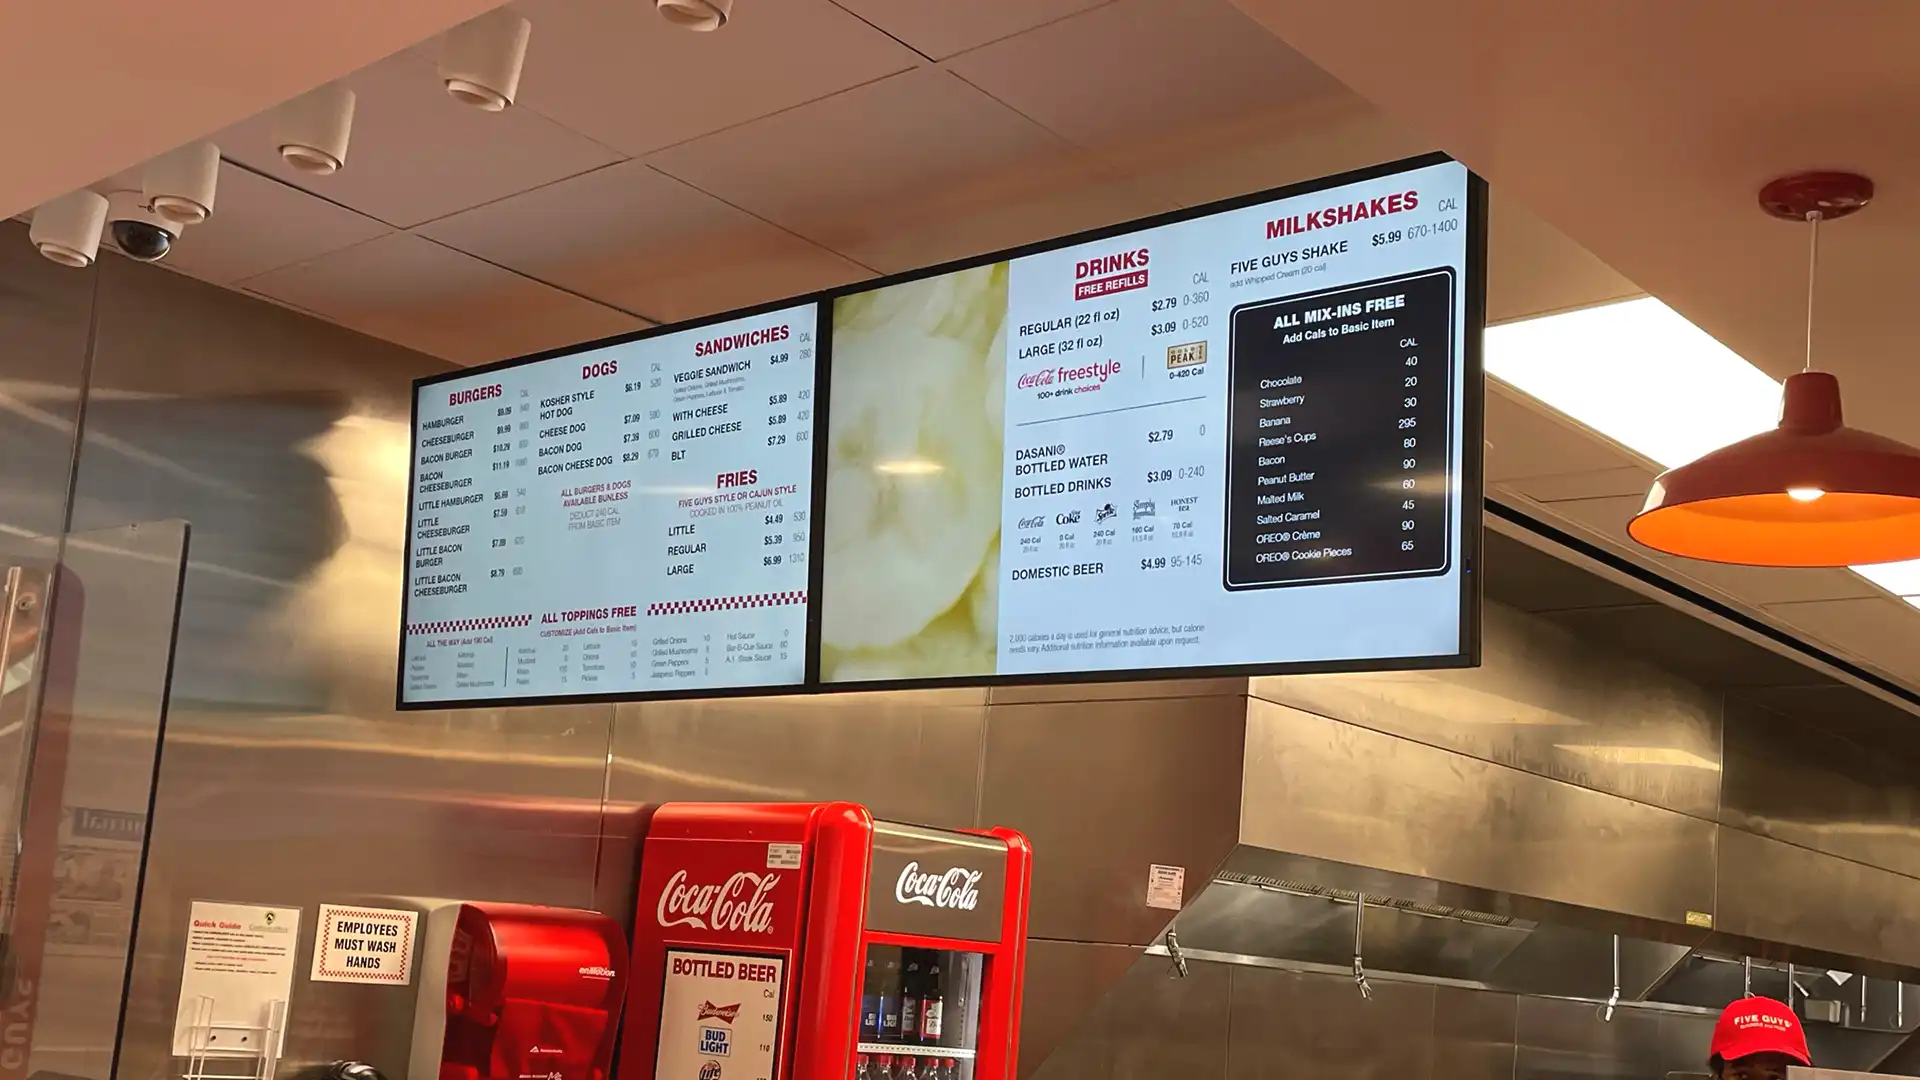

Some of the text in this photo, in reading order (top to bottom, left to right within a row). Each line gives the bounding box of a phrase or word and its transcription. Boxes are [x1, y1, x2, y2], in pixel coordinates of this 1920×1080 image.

[1438, 198, 1458, 212] CAL
[1266, 190, 1418, 239] MILKSHAKES
[1372, 218, 1458, 246] $5.99 670-1400
[1076, 248, 1149, 279] DRINKS
[1231, 240, 1348, 275] FIVE GUYS SHAKE
[1193, 272, 1209, 285] CAL
[1230, 280, 1243, 288] add
[1245, 274, 1274, 287] Whipped
[1276, 269, 1299, 280] Cream
[1301, 265, 1313, 276] (20
[1078, 275, 1145, 296] FREE REFILLS
[1152, 291, 1209, 312] $2.79 0-360
[1274, 295, 1405, 329] ALL MIX-INS FREE
[1020, 308, 1120, 337] REGULAR (22 fl oz)
[1151, 315, 1209, 336] $3.09 0-520
[1283, 318, 1394, 344] Add Cals to Basic Item
[695, 325, 789, 357] SANDWICHES
[1019, 335, 1103, 359] LARGE (32 fl oz)
[1400, 339, 1418, 347] CAL
[770, 353, 788, 365] $4.99
[1171, 355, 1194, 364] PEAK
[1406, 356, 1417, 366] 40
[582, 360, 617, 379] DOGS
[674, 360, 751, 383] VEGGIE SANDWICH
[1058, 358, 1121, 382] freestyle
[625, 382, 641, 392] $6.19
[1260, 376, 1302, 389] Chocolate
[1405, 377, 1417, 387] 20
[449, 384, 502, 406] BURGERS
[541, 390, 595, 408] KOSHER STYLE
[1260, 395, 1304, 408] Strawberry
[1404, 398, 1417, 407] 30
[540, 407, 572, 420] HOT DOG
[673, 404, 728, 422] WITH CHEESE
[422, 415, 464, 430] HAMBURGER
[1259, 417, 1291, 428] Banana
[1398, 419, 1416, 428] 295
[539, 423, 585, 438] CHEESE DOG
[672, 422, 742, 441] GRILLED CHEESE
[1148, 425, 1205, 442] $2.79 0
[421, 431, 474, 447] CHEESEBURGER
[768, 435, 785, 446] $7.29
[1259, 433, 1316, 447] Reese's Cups
[1404, 439, 1416, 448] 80
[539, 442, 581, 457] BACON DOG
[672, 450, 686, 461] BLT
[421, 449, 472, 465] BACON BURGER
[1259, 456, 1285, 466] Bacon
[538, 456, 612, 475] BACON CHEESE DOG
[1016, 454, 1108, 475] BOTTLED WATER
[1403, 460, 1415, 468] 90
[420, 471, 443, 482] BACON
[717, 469, 757, 488] FRIES
[1147, 466, 1204, 483] $3.09 0-240
[1258, 472, 1315, 485] Peanut Butter
[419, 478, 472, 493] CHEESEBURGER
[1015, 477, 1111, 498] BOTTLED DRINKS
[1403, 480, 1415, 489] 60
[419, 494, 483, 510] LITTLE HAMBURGER
[563, 492, 628, 507] AVAILABLE BUNLESS
[678, 484, 796, 507] FIVE GUYS STYLE OR CAJUN STYLE
[1171, 497, 1198, 506] HONEST
[1257, 493, 1304, 505] Malted Milk
[1402, 501, 1414, 510] 45
[418, 517, 438, 528] LITTLE
[765, 514, 783, 525] $4.49
[1257, 510, 1320, 525] Salted Caramel
[668, 525, 695, 536] LITTLE
[1402, 520, 1414, 530] 90
[417, 525, 470, 539] CHEESEBURGER
[1293, 530, 1320, 541] Crème
[764, 535, 782, 546] $5.39
[1401, 541, 1413, 550] 65
[416, 544, 462, 556] LITTLE BACON
[668, 543, 706, 556] REGULAR
[416, 557, 443, 568] BURGER
[764, 556, 781, 567] $6.99
[1141, 554, 1202, 571] $4.99 95-145
[667, 564, 694, 575] LARGE
[1012, 563, 1104, 580] DOMESTIC BEER
[415, 574, 461, 586] LITTLE BACON
[414, 584, 467, 597] CHEESEBURGER
[541, 606, 637, 624] ALL TOPPINGS FREE
[896, 861, 982, 911] Coca-Cola
[193, 919, 216, 928] Quick
[219, 921, 241, 930] Guide
[337, 921, 398, 936] EMPLOYEES
[335, 938, 396, 953] MUST WASH
[346, 956, 380, 968] HANDS
[672, 958, 776, 983] BOTTLED BEER
[763, 989, 775, 998] Cal
[763, 1014, 772, 1022] 150
[1734, 1015, 1758, 1025] FIVE
[1762, 1015, 1790, 1028] GUYS
[706, 1030, 725, 1041] BUD
[700, 1041, 728, 1054] LIGHT
[760, 1044, 769, 1052] 110
